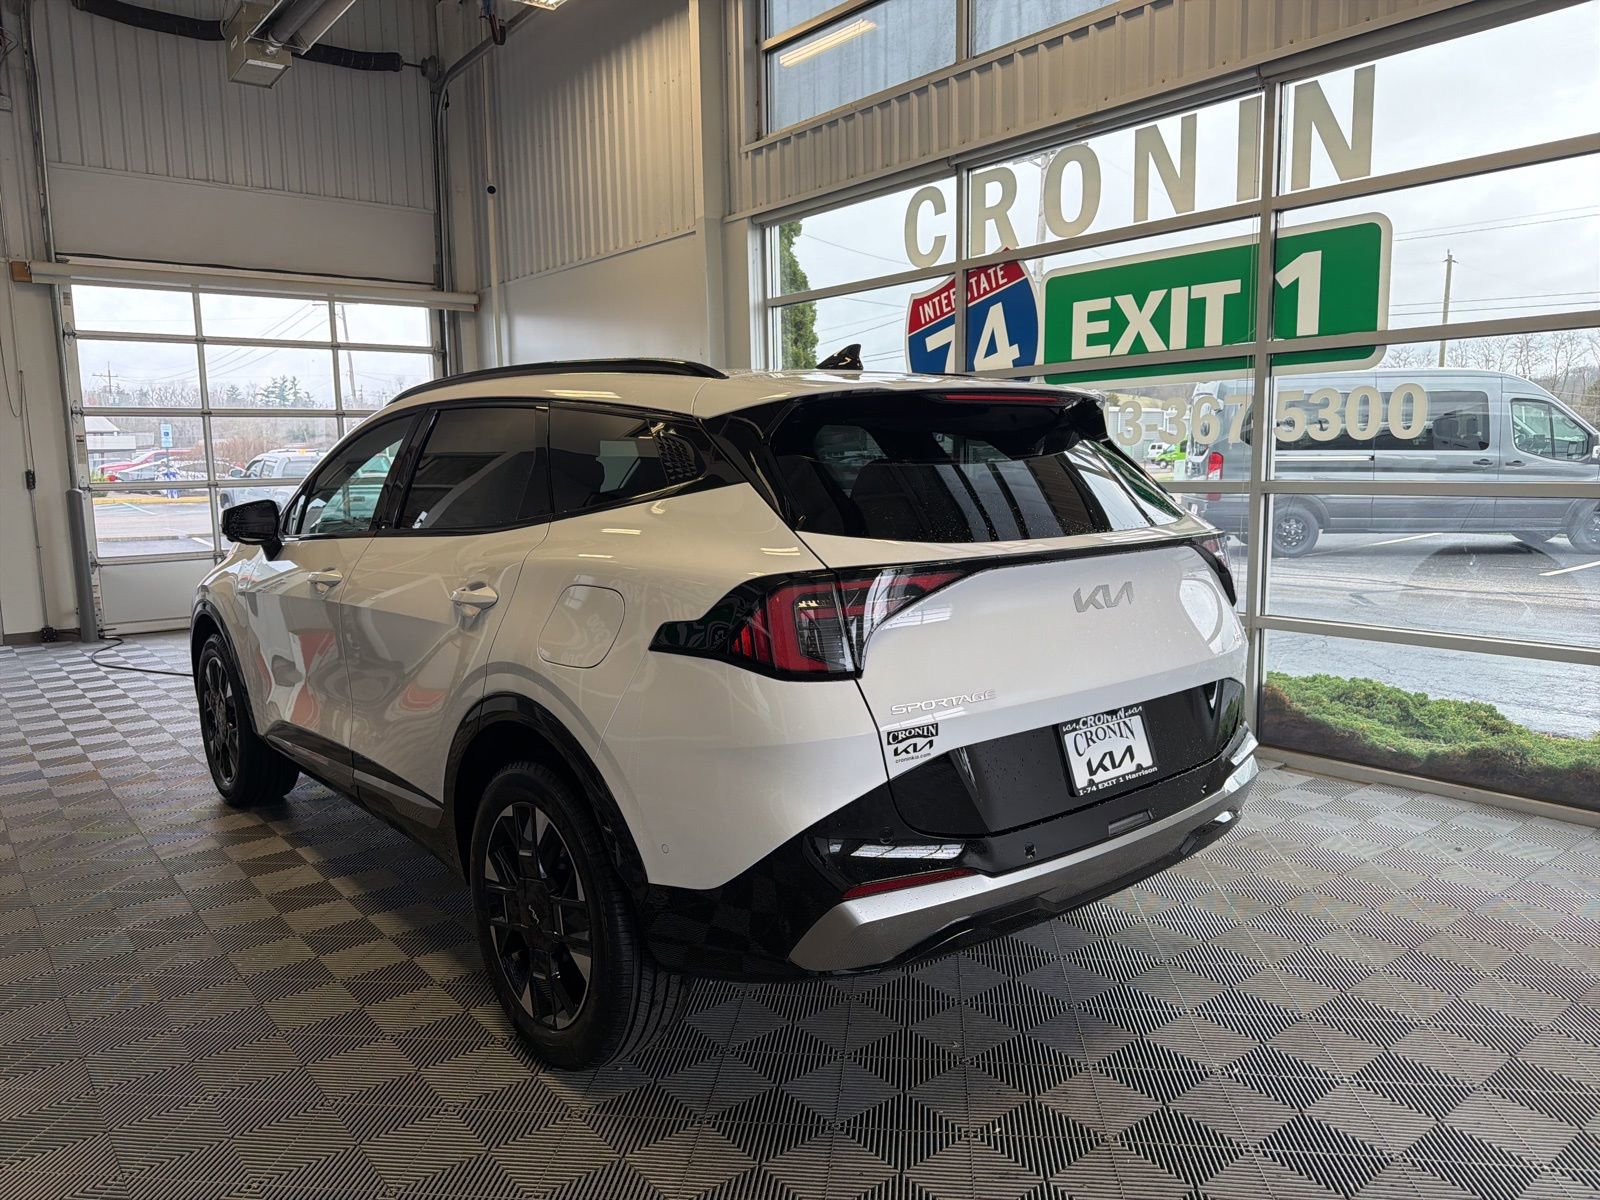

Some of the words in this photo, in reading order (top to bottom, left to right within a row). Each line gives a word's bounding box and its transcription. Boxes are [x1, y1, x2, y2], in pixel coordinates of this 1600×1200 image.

[904, 65, 1376, 268] CRONIN
[919, 264, 1008, 325] INTERTATE
[1071, 278, 1242, 360] EXIT
[1274, 250, 1323, 337] 1
[924, 301, 1021, 374] 74
[1072, 580, 1134, 613] KIA
[890, 688, 996, 716] SPORTAGE
[888, 723, 938, 745] CRONIN
[893, 739, 934, 757] KIA
[1073, 718, 1136, 758] CRONIN
[895, 752, 932, 764] croninkia.com
[1086, 744, 1135, 777] KIA
[1078, 784, 1098, 796] I-74
[1098, 778, 1118, 790] EXIT
[1125, 766, 1158, 781] Harrison
